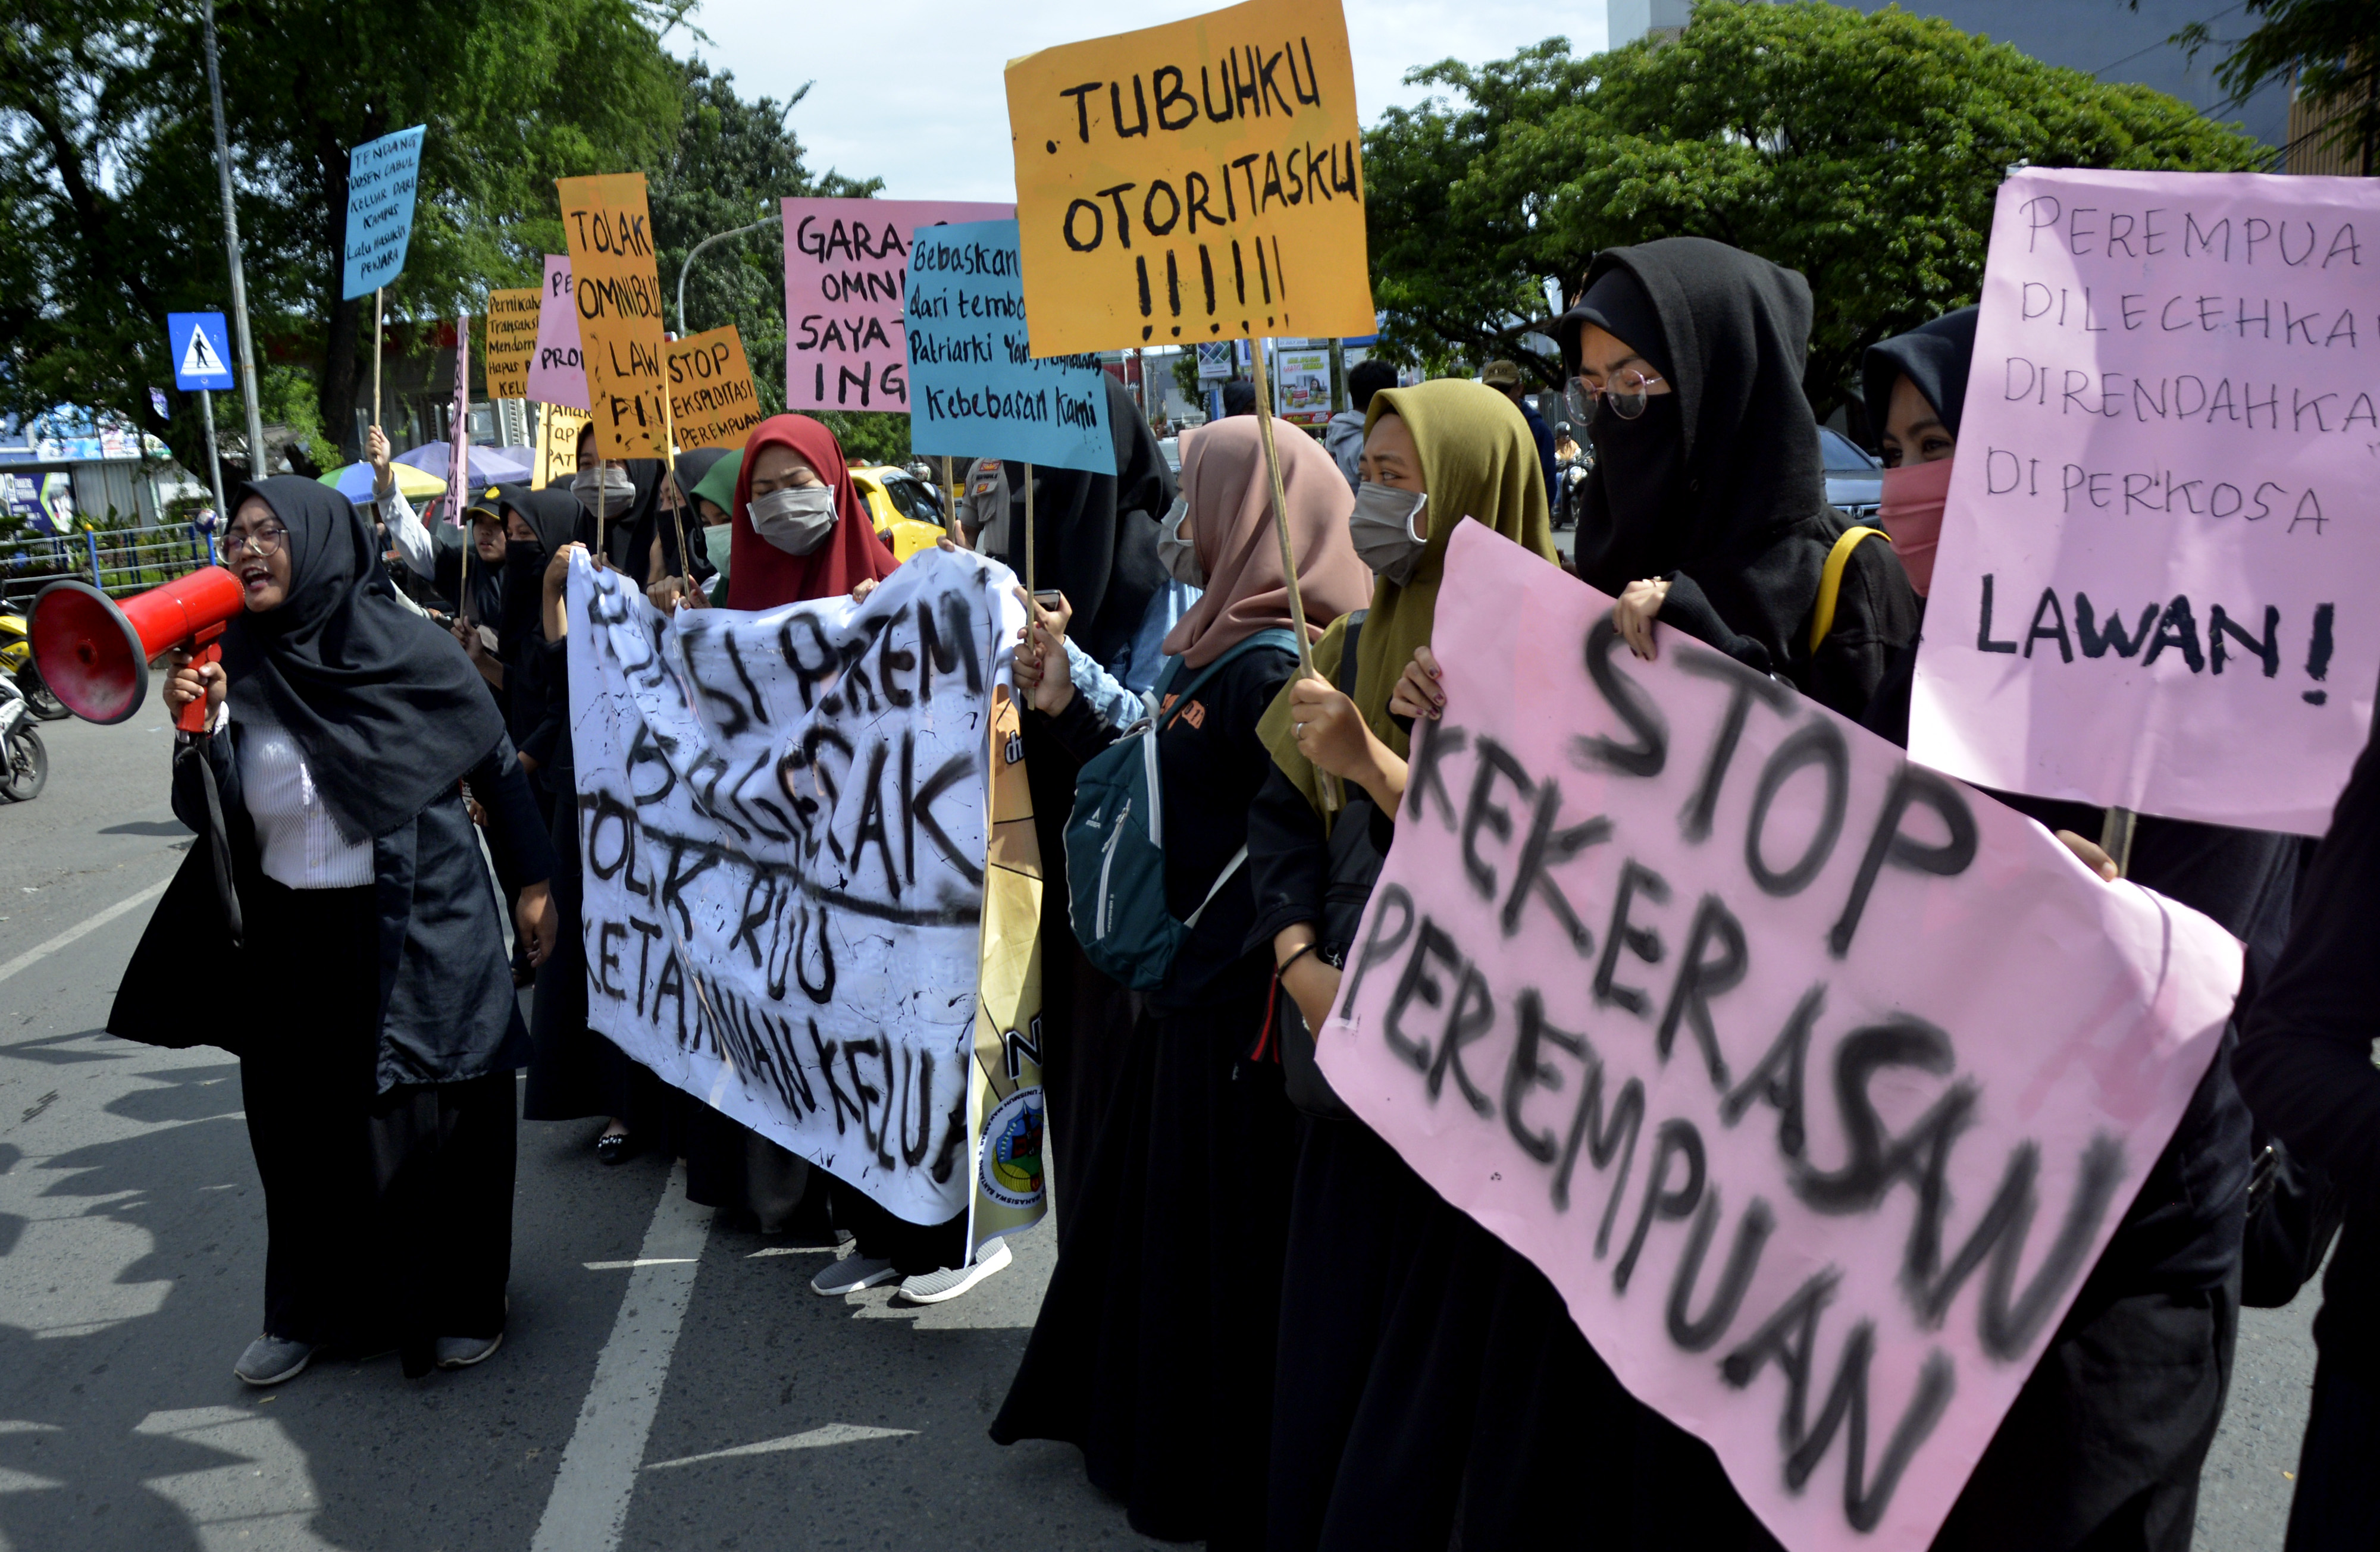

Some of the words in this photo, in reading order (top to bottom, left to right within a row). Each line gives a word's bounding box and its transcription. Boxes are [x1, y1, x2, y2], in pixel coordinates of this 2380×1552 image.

[1060, 36, 1320, 143] TUBUHKU
[355, 133, 417, 169] TENDANG
[350, 169, 381, 191] DOSEN
[384, 156, 415, 177] CABUL
[350, 188, 387, 213] KELUAR
[393, 175, 415, 196] DARI
[1063, 140, 1359, 252] OTORITASKU
[364, 203, 399, 230] KAMPUS
[571, 209, 653, 256] TOLAK
[2020, 195, 2361, 269] PEREMPUA
[913, 240, 1020, 277] Bebaskan
[822, 268, 906, 303] OMNI
[909, 284, 948, 319] dari
[1136, 236, 1289, 341] !!!!!!
[488, 315, 539, 335] Transaksi
[796, 315, 890, 353] SAYA
[609, 340, 659, 377] LAW
[668, 341, 730, 383] STOP
[909, 330, 993, 365] Patriarki
[488, 361, 519, 375] Hapus
[669, 378, 753, 418] EKSPLOITASI
[926, 385, 1048, 421] Kebebasan
[1056, 385, 1097, 428] Kami
[679, 410, 764, 449] PEREMPUAN
[1977, 573, 2335, 707] LAWAN!
[1567, 607, 1978, 958] STOP
[1407, 716, 2130, 1363] KEKERASAN
[1004, 1089, 1038, 1107] UNISMUH
[979, 1106, 1004, 1146] MAKASSAR
[978, 1159, 995, 1196] BANTAENG
[995, 1192, 1041, 1205] MAHASISWA
[1339, 881, 1958, 1536] PEREMPUAN
